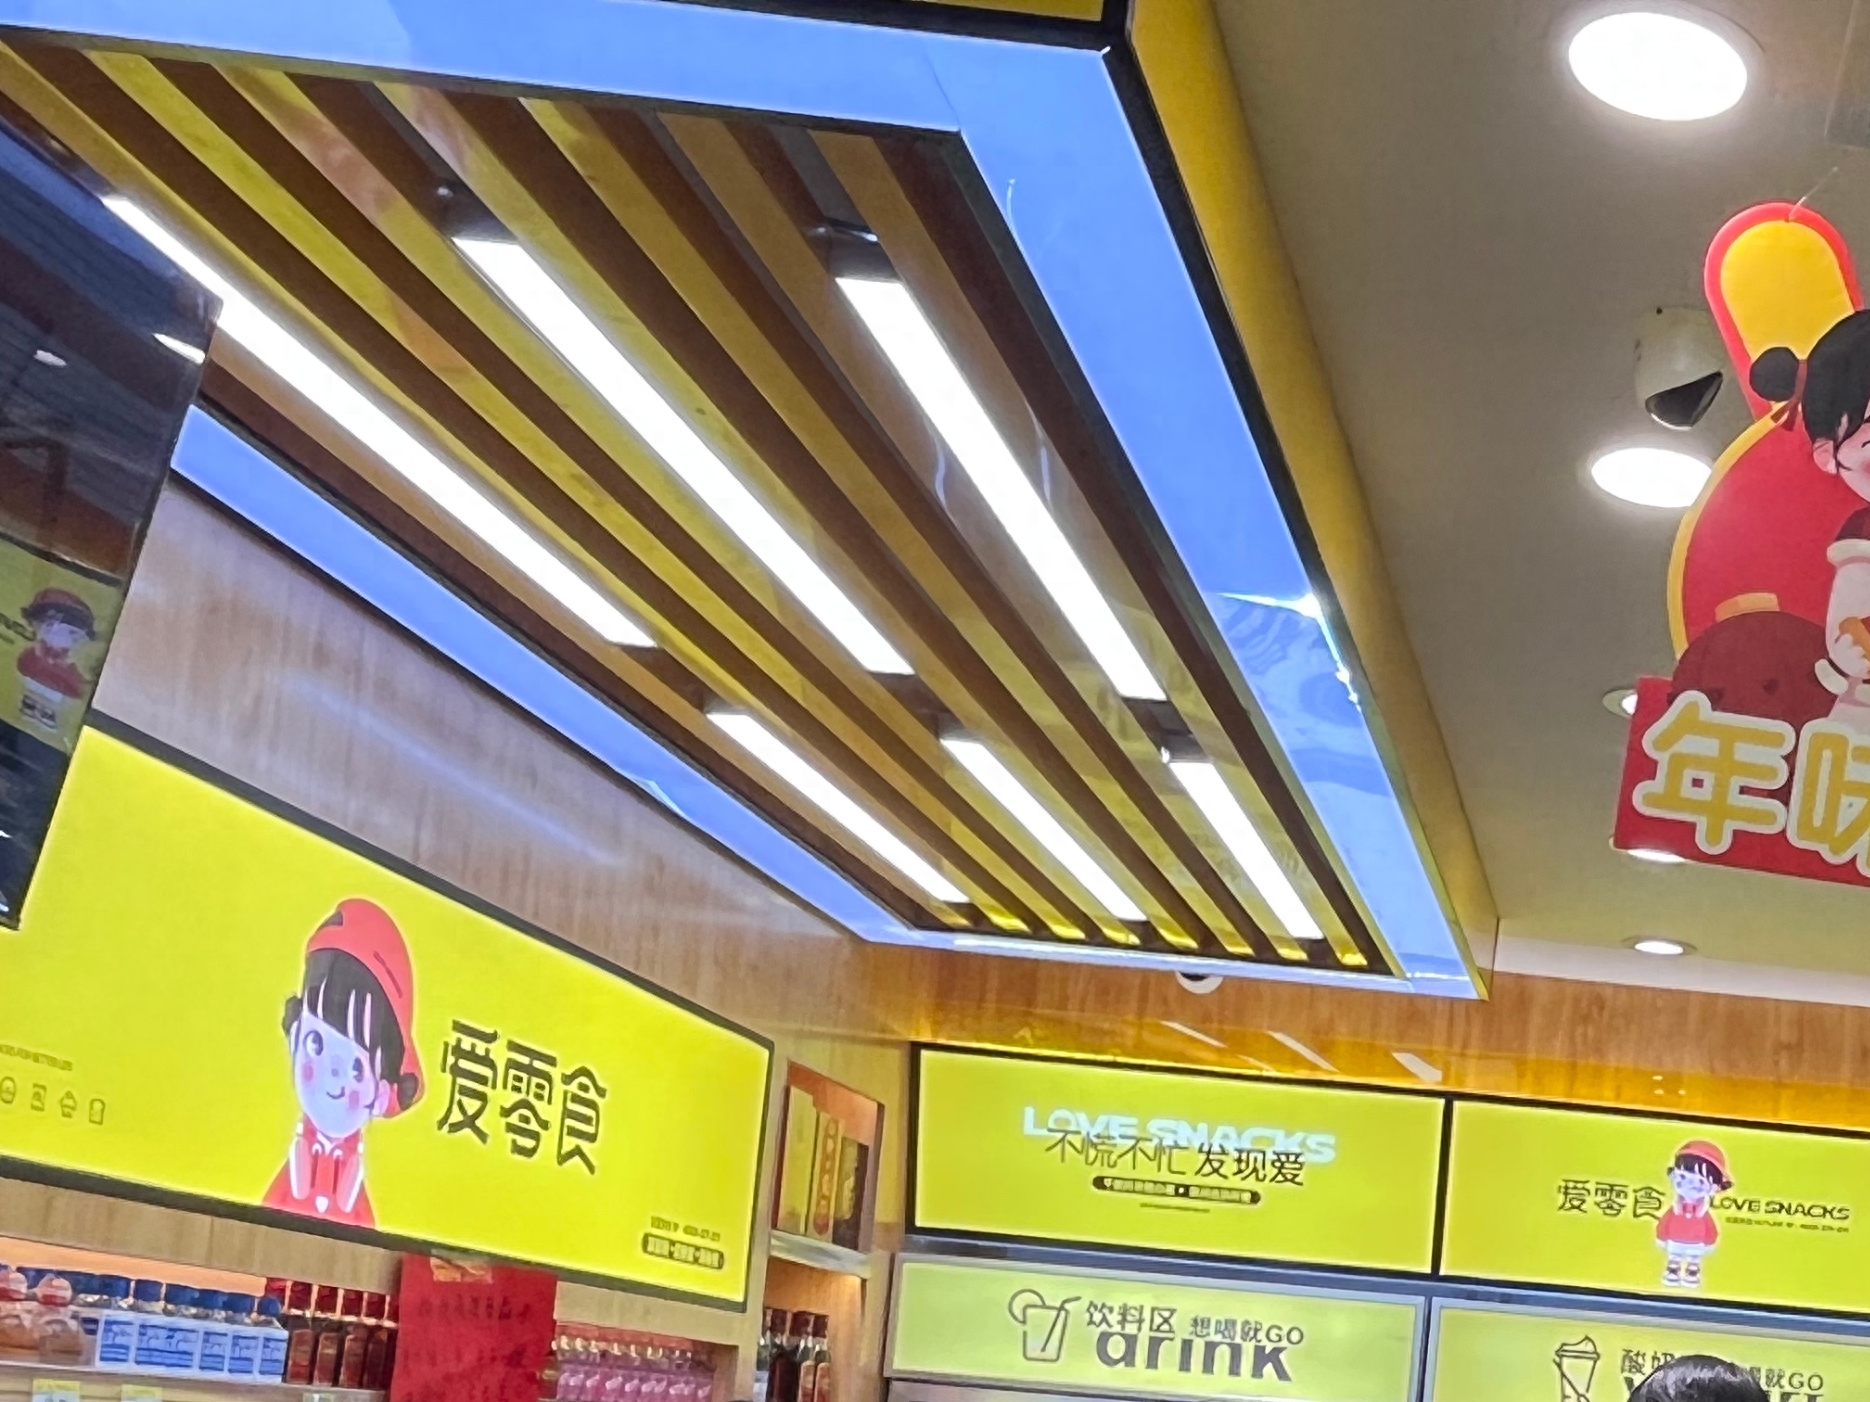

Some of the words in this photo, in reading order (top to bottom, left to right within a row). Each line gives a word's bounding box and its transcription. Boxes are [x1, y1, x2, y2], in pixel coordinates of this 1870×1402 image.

[437, 1019, 607, 1176] 爱零食
[1023, 1106, 1139, 1146] LOVE
[1146, 1116, 1336, 1163] SNACKS
[1046, 1127, 1188, 1176] 不慌不忙
[1195, 1142, 1305, 1186] 发现爱
[1557, 1178, 1665, 1220] 爱零食
[1710, 1195, 1761, 1213] LOVE
[1764, 1200, 1851, 1221] SNACKS
[1086, 1300, 1177, 1334] 饮料区
